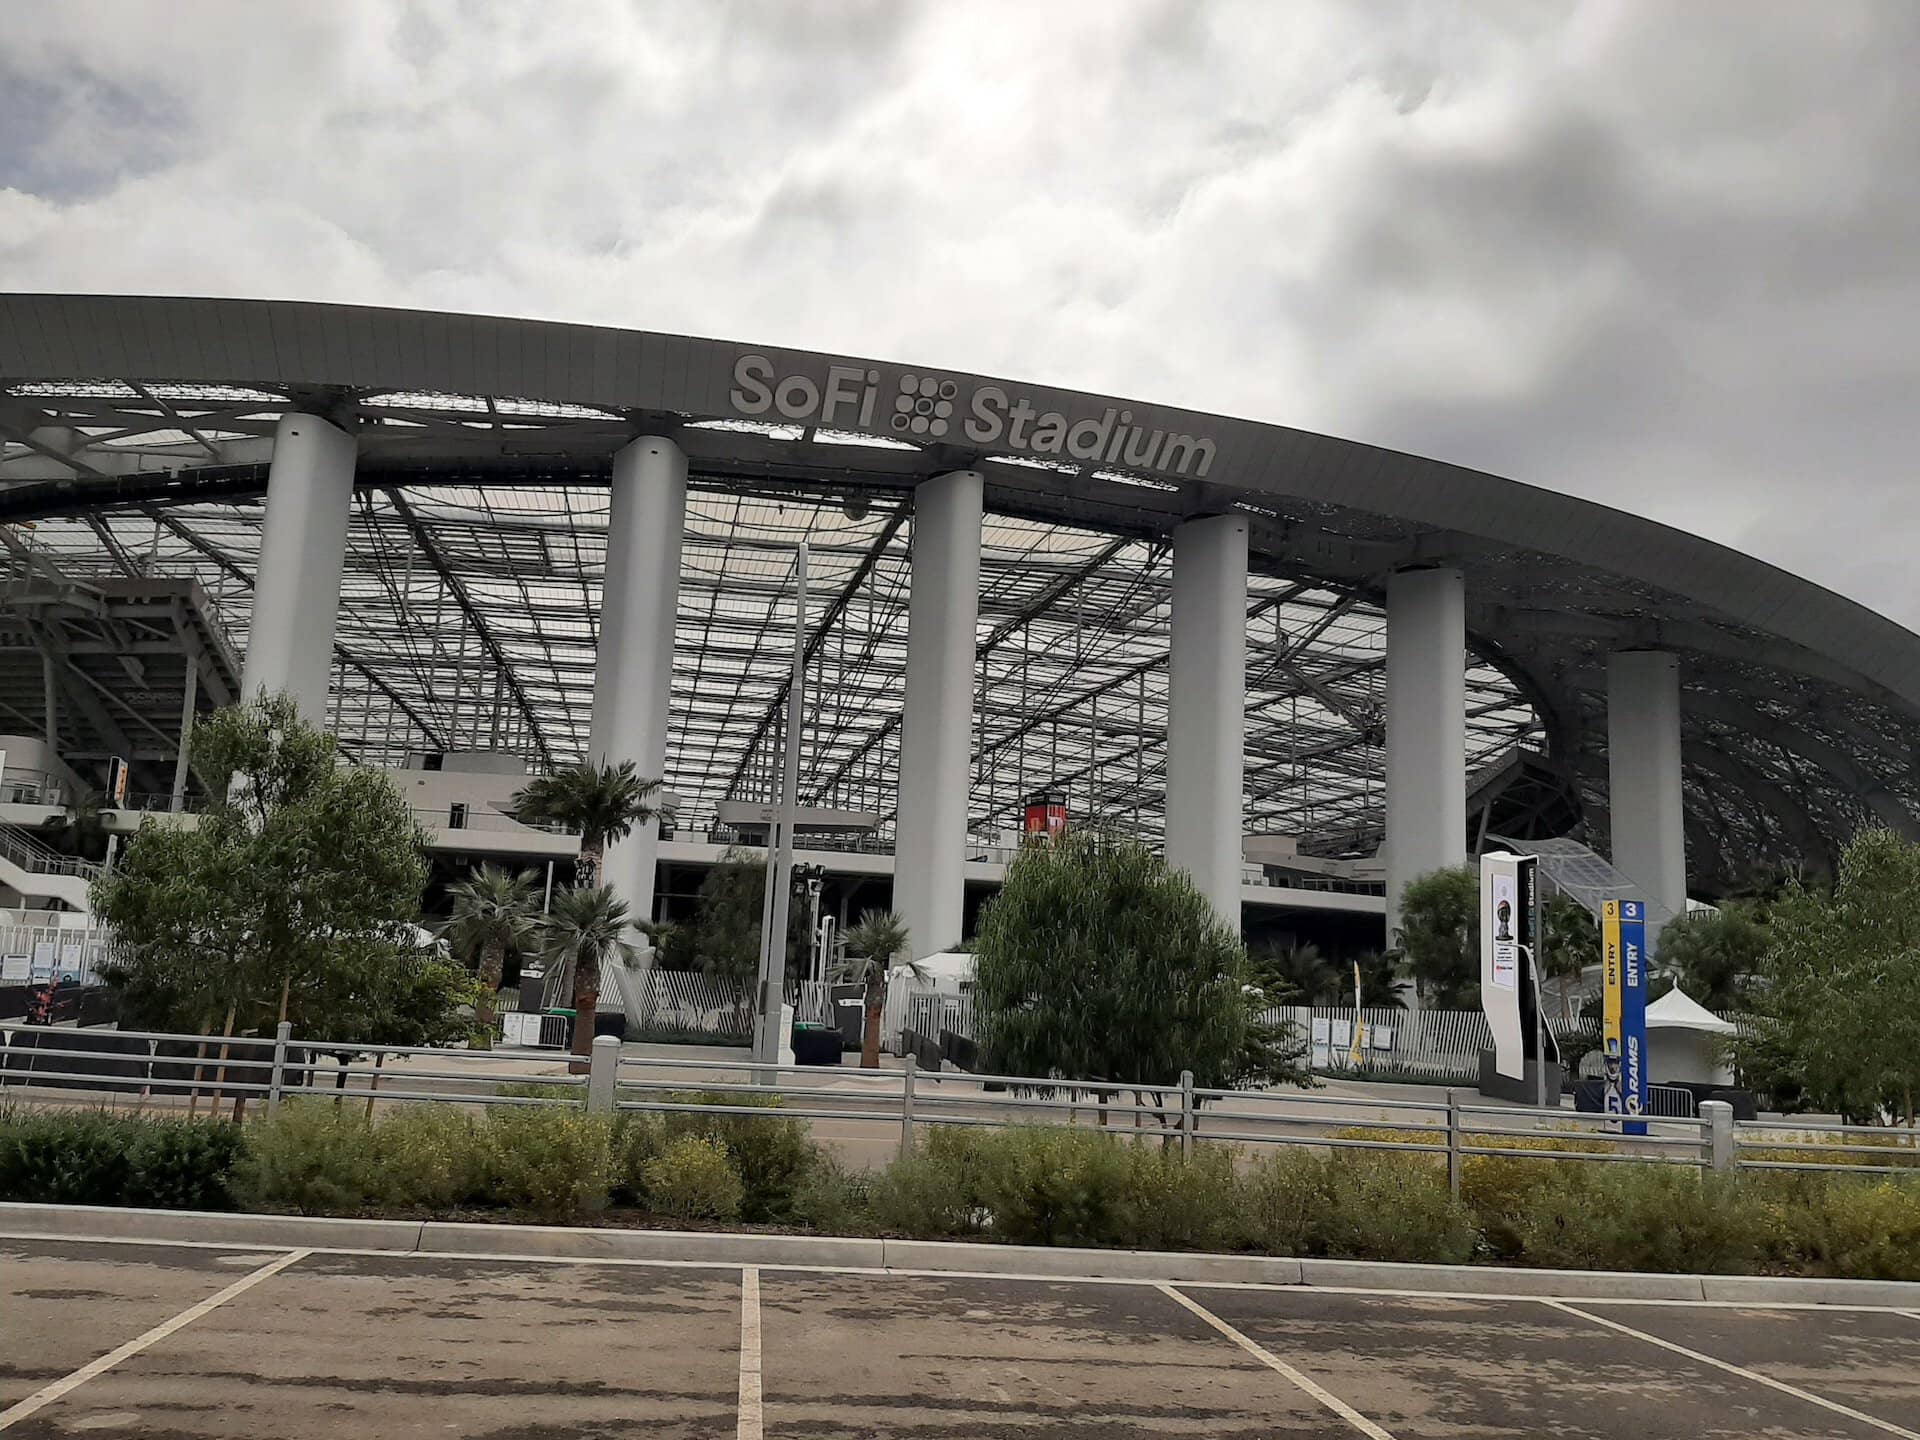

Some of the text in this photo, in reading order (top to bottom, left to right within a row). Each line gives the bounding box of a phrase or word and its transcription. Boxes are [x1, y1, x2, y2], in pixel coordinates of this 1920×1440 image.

[730, 354, 1217, 477] SoFi Stadium
[1527, 867, 1535, 906] Stadium
[1607, 902, 1614, 916] 3
[1625, 902, 1637, 917] 3
[1608, 942, 1616, 986] ENTRY
[1626, 942, 1639, 987] ENTRY
[1628, 1035, 1639, 1093] RAMS
